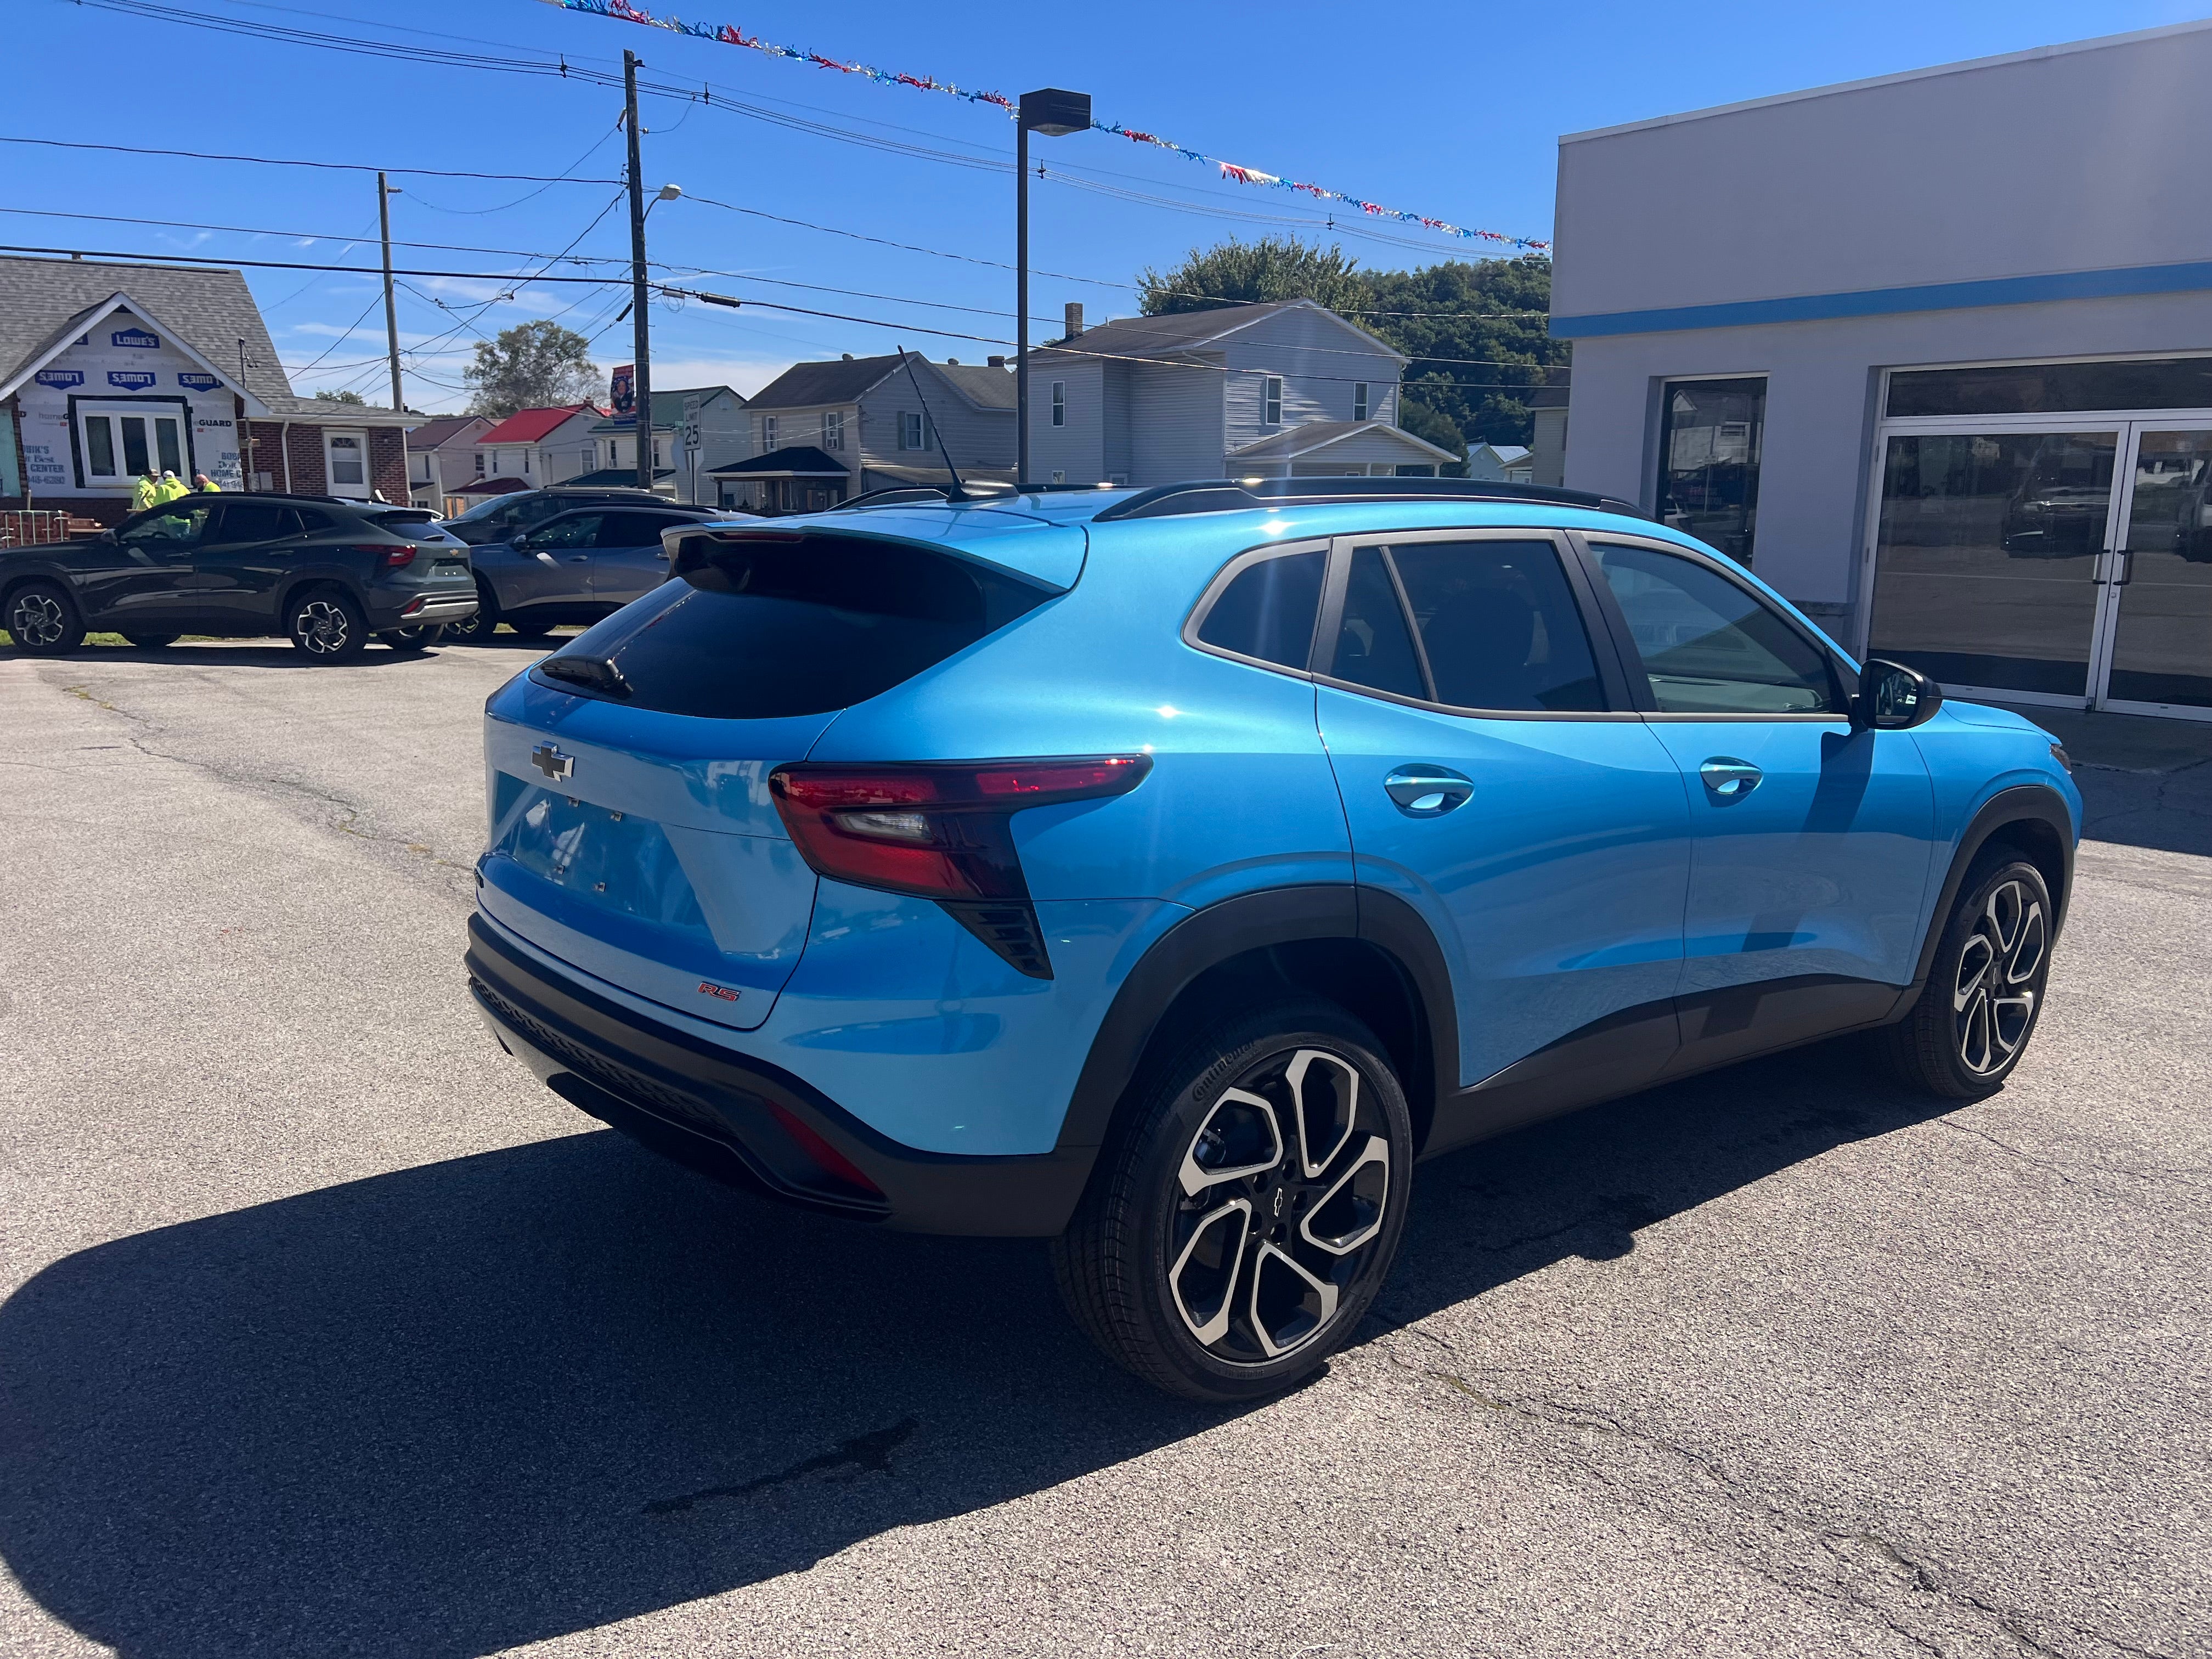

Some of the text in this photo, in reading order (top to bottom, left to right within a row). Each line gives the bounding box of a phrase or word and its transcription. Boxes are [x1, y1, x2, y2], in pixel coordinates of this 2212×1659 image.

[116, 334, 155, 346] LOWE'S
[38, 371, 80, 382] LOWE'S
[112, 373, 151, 384] LOWE'S
[684, 400, 698, 410] SPEED
[686, 412, 697, 421] LIMIT
[685, 425, 699, 445] 25
[31, 464, 65, 473] CENTER
[211, 469, 234, 478] HOME
[697, 981, 740, 1002] RS
[1192, 1040, 1256, 1102] Continental
